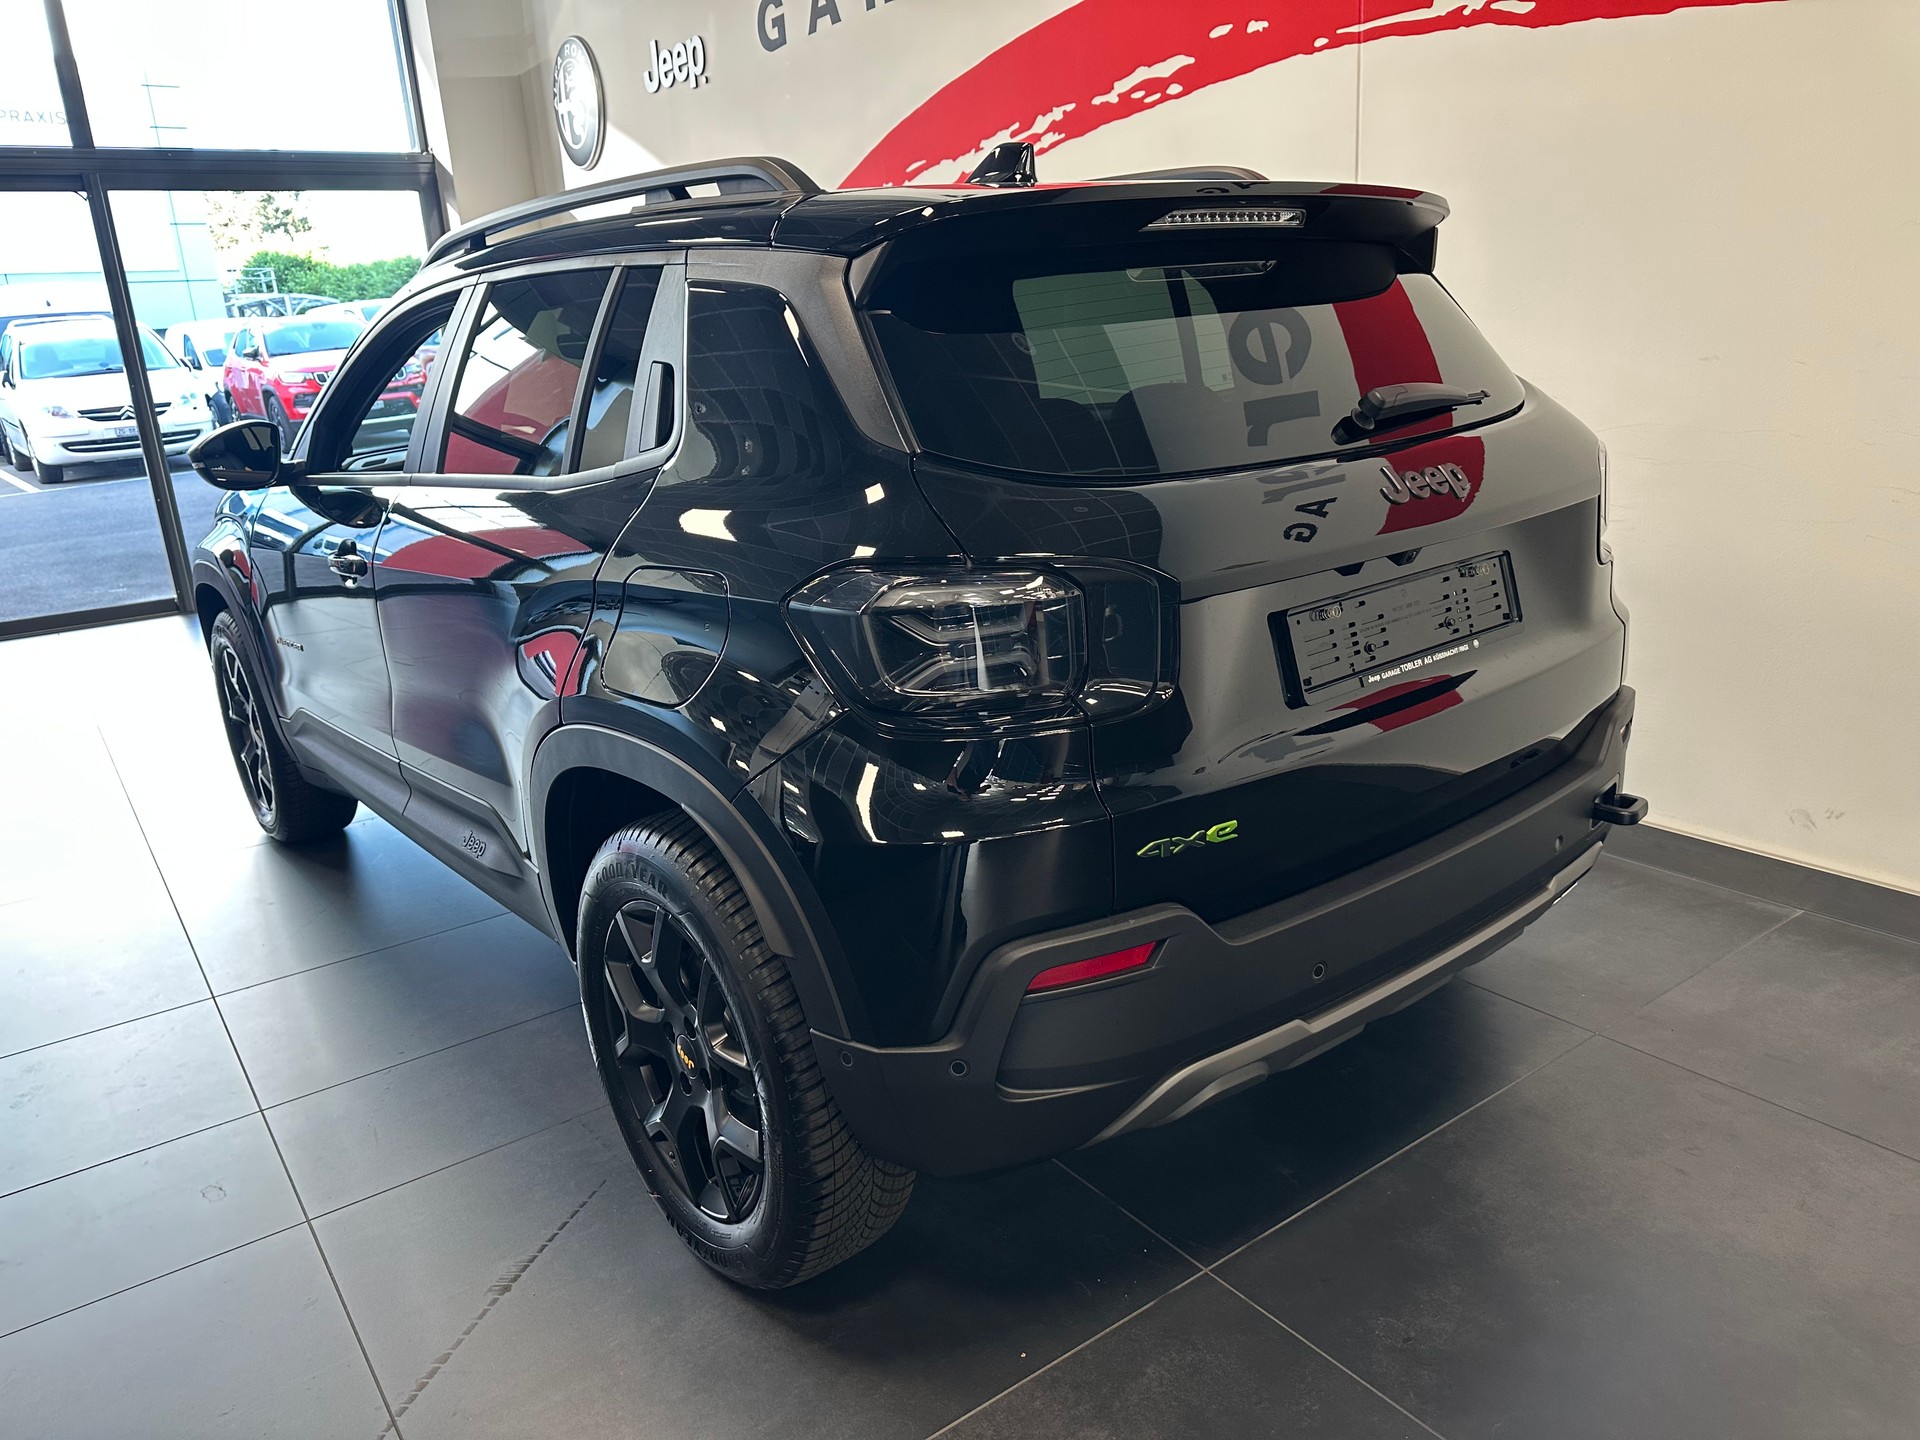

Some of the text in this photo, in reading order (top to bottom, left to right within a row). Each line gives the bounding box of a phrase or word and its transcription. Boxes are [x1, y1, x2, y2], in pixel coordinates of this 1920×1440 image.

[757, 0, 895, 52] GA
[0, 110, 67, 125] PRAXIS
[1379, 462, 1471, 504] Jeep
[1368, 674, 1381, 683] Jeep
[1381, 667, 1401, 679] GARAGE
[1400, 658, 1423, 672] TOBLER
[1424, 655, 1433, 665] AG
[461, 830, 487, 860] Jeep
[595, 860, 669, 900] GOODYEAR
